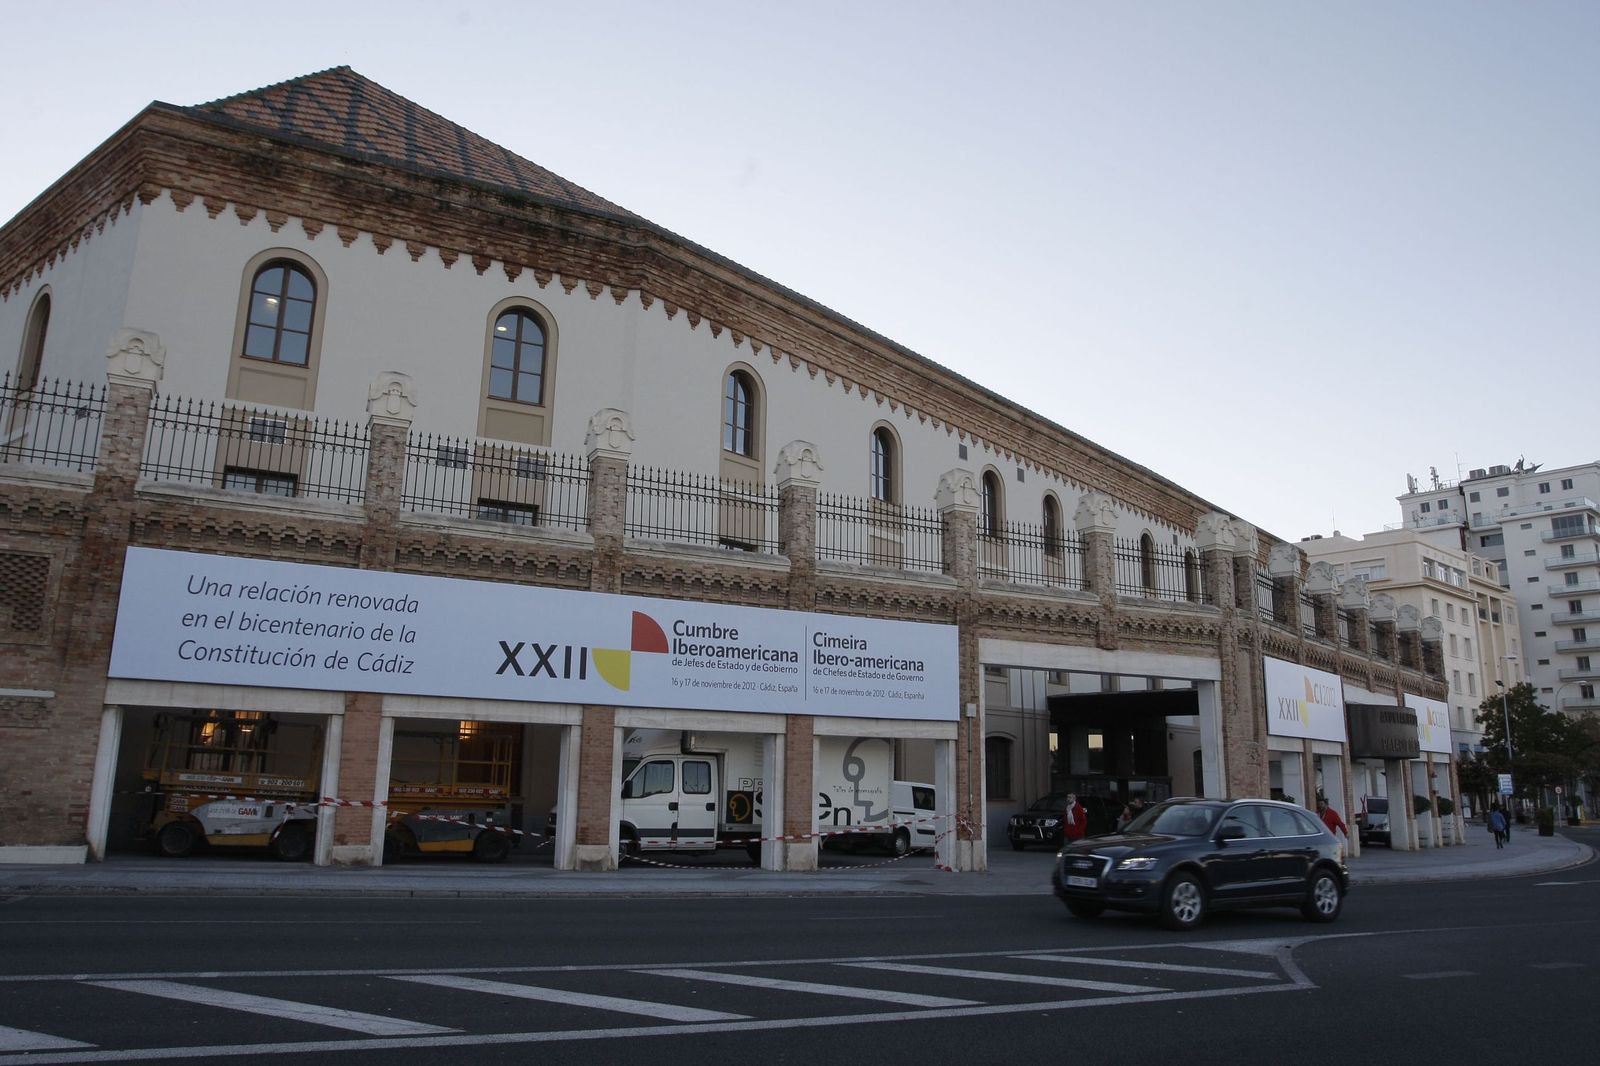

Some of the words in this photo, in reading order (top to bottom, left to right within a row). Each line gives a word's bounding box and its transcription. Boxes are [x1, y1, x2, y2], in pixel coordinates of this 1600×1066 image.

[187, 574, 232, 598] Una
[238, 581, 321, 605] relación
[327, 592, 419, 613] renovada
[182, 612, 208, 628] en
[214, 611, 234, 629] el
[239, 612, 365, 640] bicentenario
[370, 623, 394, 642] de
[399, 625, 416, 643] la
[673, 620, 739, 640] Cumbre
[672, 638, 798, 662] Iberoamericana
[813, 632, 867, 650] Cimeira
[178, 640, 316, 668] Constitución
[324, 650, 348, 670] de
[358, 652, 415, 674] Cádiz
[494, 640, 588, 680] XXII
[672, 658, 682, 666] de
[683, 658, 704, 667] Jefes
[706, 660, 715, 668] de
[718, 660, 744, 670] Estado
[751, 662, 761, 671] de
[762, 663, 798, 674] Gobierno
[813, 649, 924, 672] Ibero-americana
[692, 679, 700, 687] de
[701, 680, 732, 689] noviembre
[734, 681, 741, 689] de
[742, 681, 756, 690] 2012
[778, 684, 798, 693] España
[823, 668, 847, 676] Chefes
[858, 670, 880, 679] Estado
[886, 672, 895, 680] de
[896, 673, 924, 682] Governo
[904, 691, 924, 699] Espanha
[1278, 696, 1299, 721] XXII
